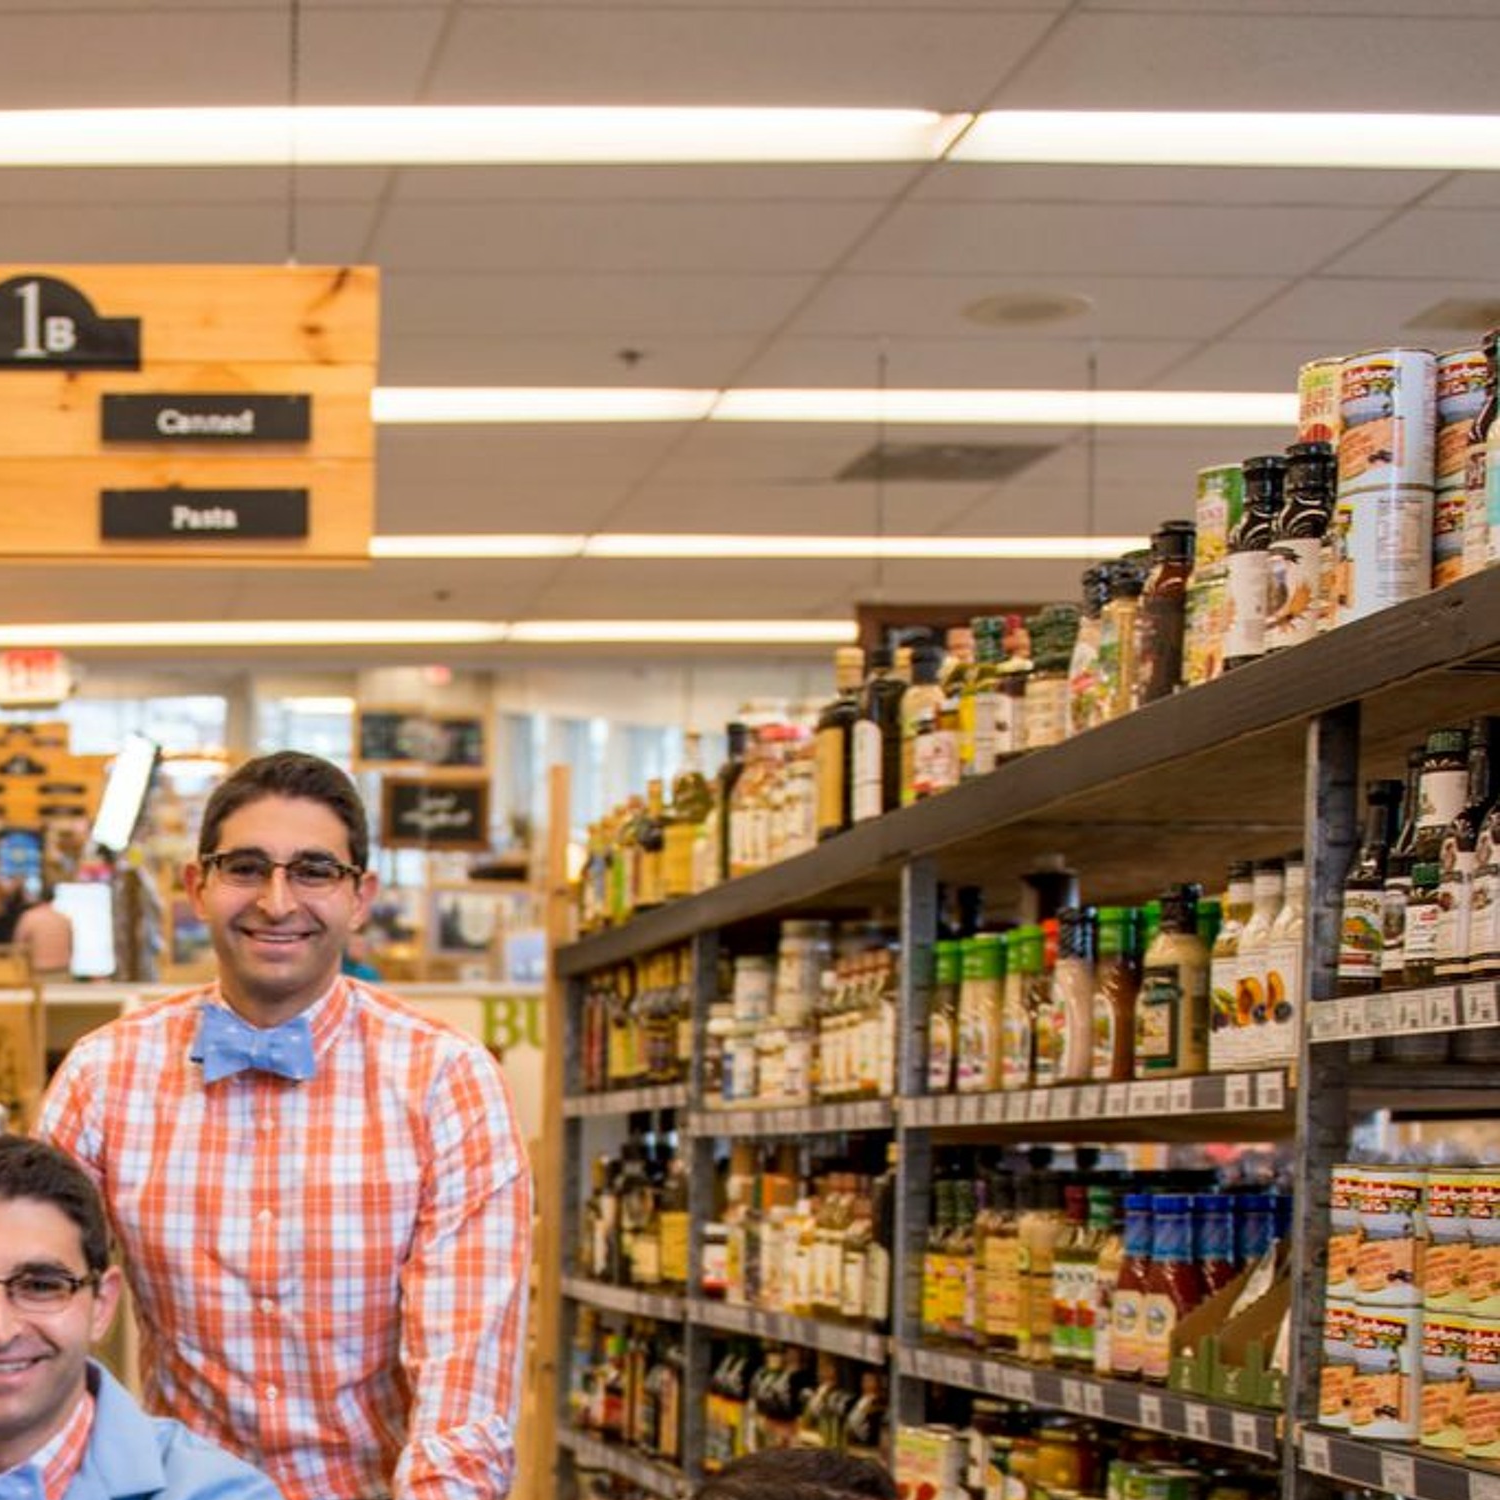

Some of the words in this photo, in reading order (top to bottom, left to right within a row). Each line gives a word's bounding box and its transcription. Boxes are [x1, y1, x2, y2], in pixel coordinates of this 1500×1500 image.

[13, 281, 77, 358] 1B
[156, 409, 255, 435] Canned
[171, 506, 238, 530] Pasta
